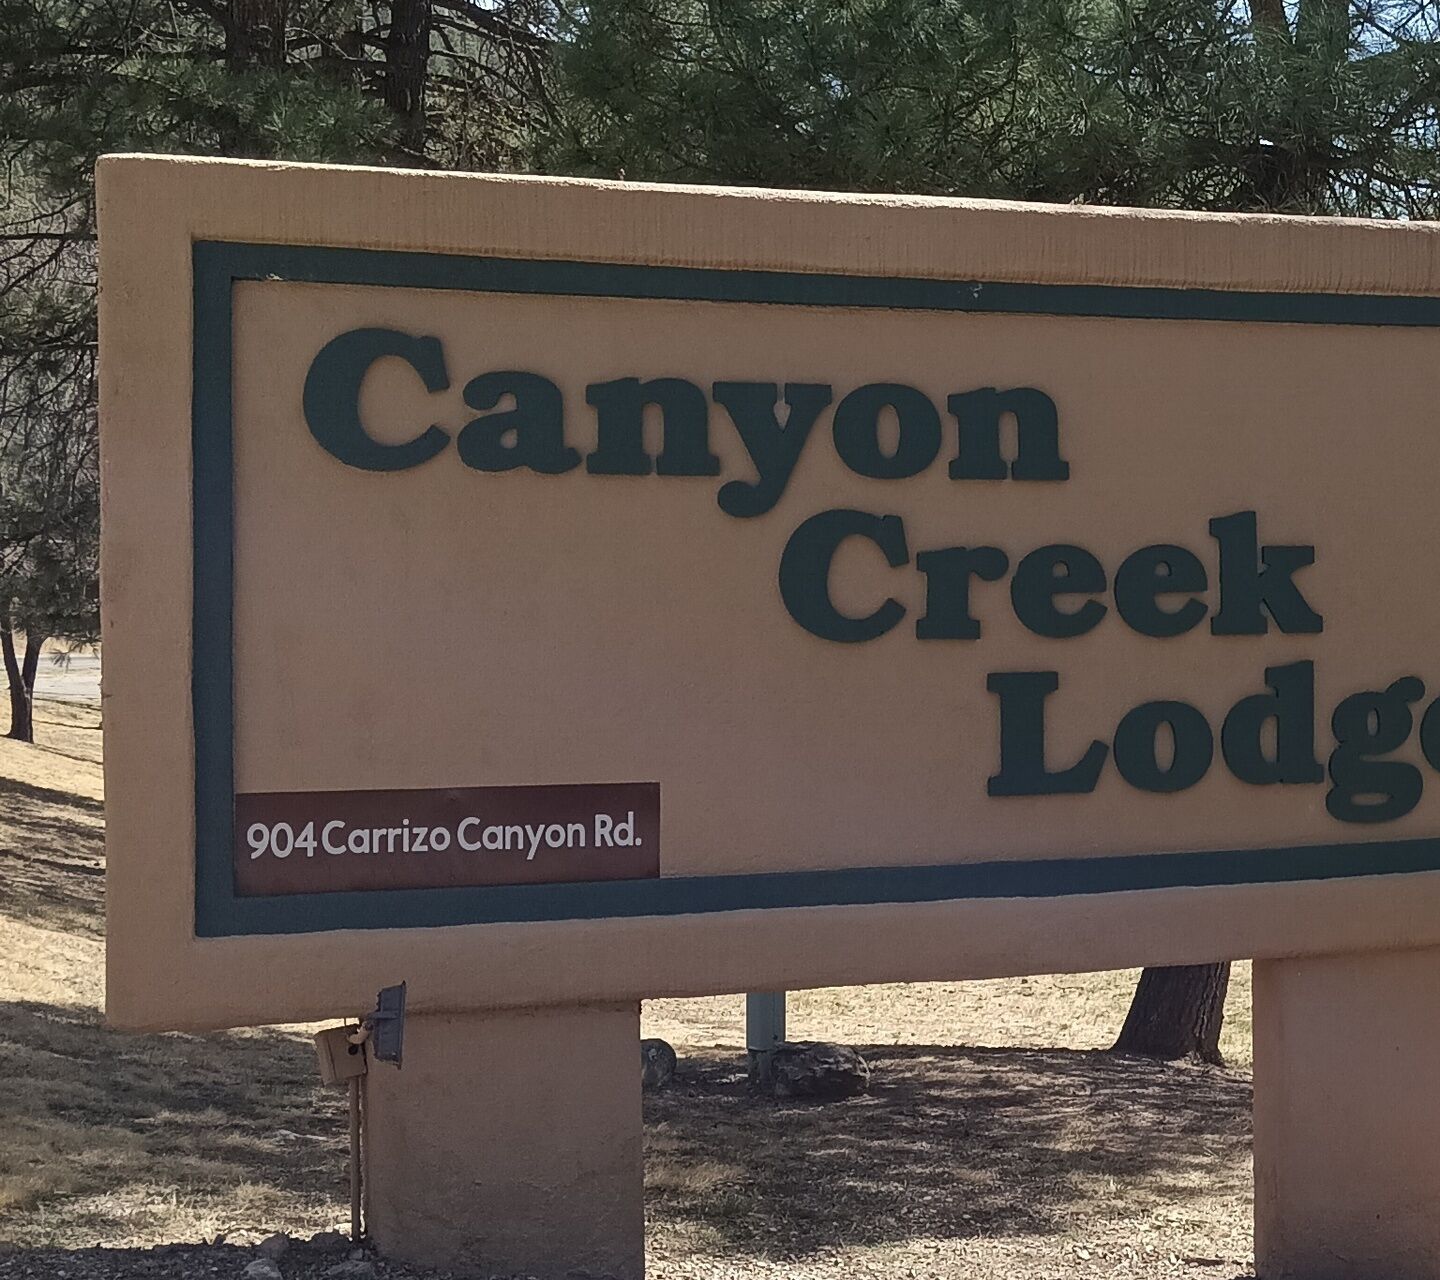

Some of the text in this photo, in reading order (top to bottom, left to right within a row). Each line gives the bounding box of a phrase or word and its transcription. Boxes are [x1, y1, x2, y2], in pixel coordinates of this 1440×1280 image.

[304, 327, 1070, 518] Canyon
[778, 508, 1325, 643] Creek
[247, 811, 642, 860] 904 Carrizo Canyon Rd.
